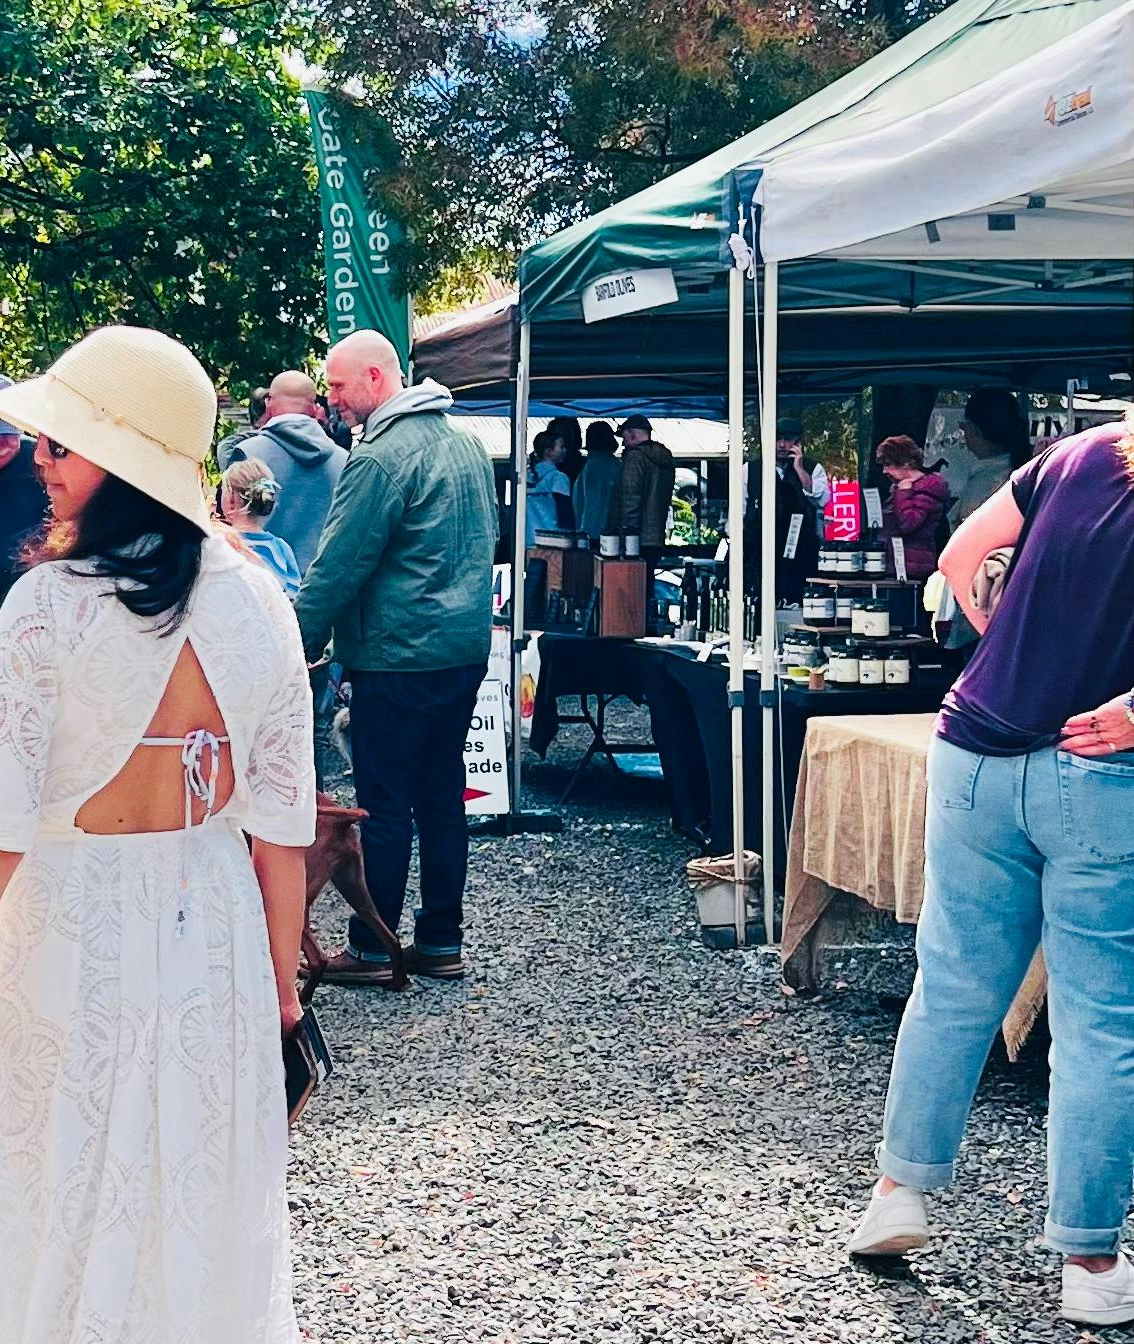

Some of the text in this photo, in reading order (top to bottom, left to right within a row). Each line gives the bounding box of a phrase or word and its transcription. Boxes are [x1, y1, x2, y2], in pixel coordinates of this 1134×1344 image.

[329, 202, 360, 335] Garden
[832, 478, 860, 542] LLERY
[470, 716, 495, 731] Oil
[465, 741, 485, 753] es
[468, 758, 503, 774] ade
